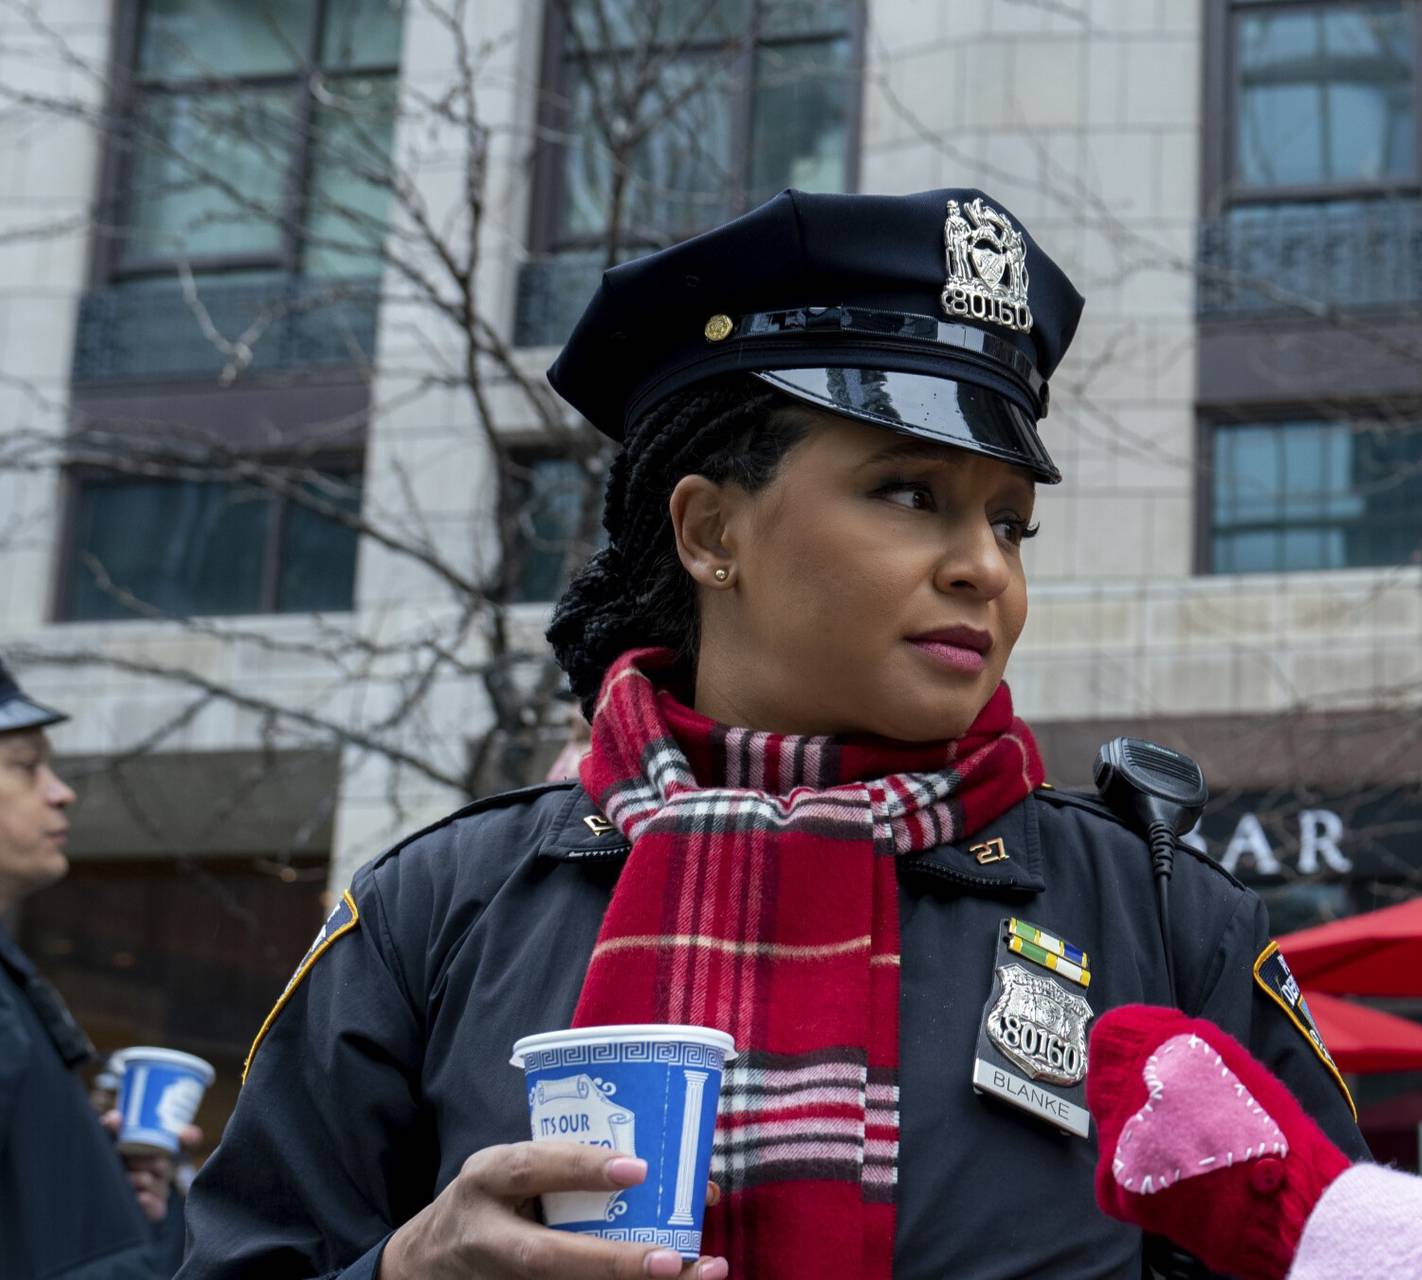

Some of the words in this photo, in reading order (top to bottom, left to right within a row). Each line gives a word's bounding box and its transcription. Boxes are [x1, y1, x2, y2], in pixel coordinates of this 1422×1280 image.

[953, 288, 1030, 329] 80160
[1180, 808, 1353, 875] AR
[1003, 1016, 1081, 1075] 80160
[993, 1070, 1070, 1121] BLANKE
[559, 1114, 590, 1133] OUR
